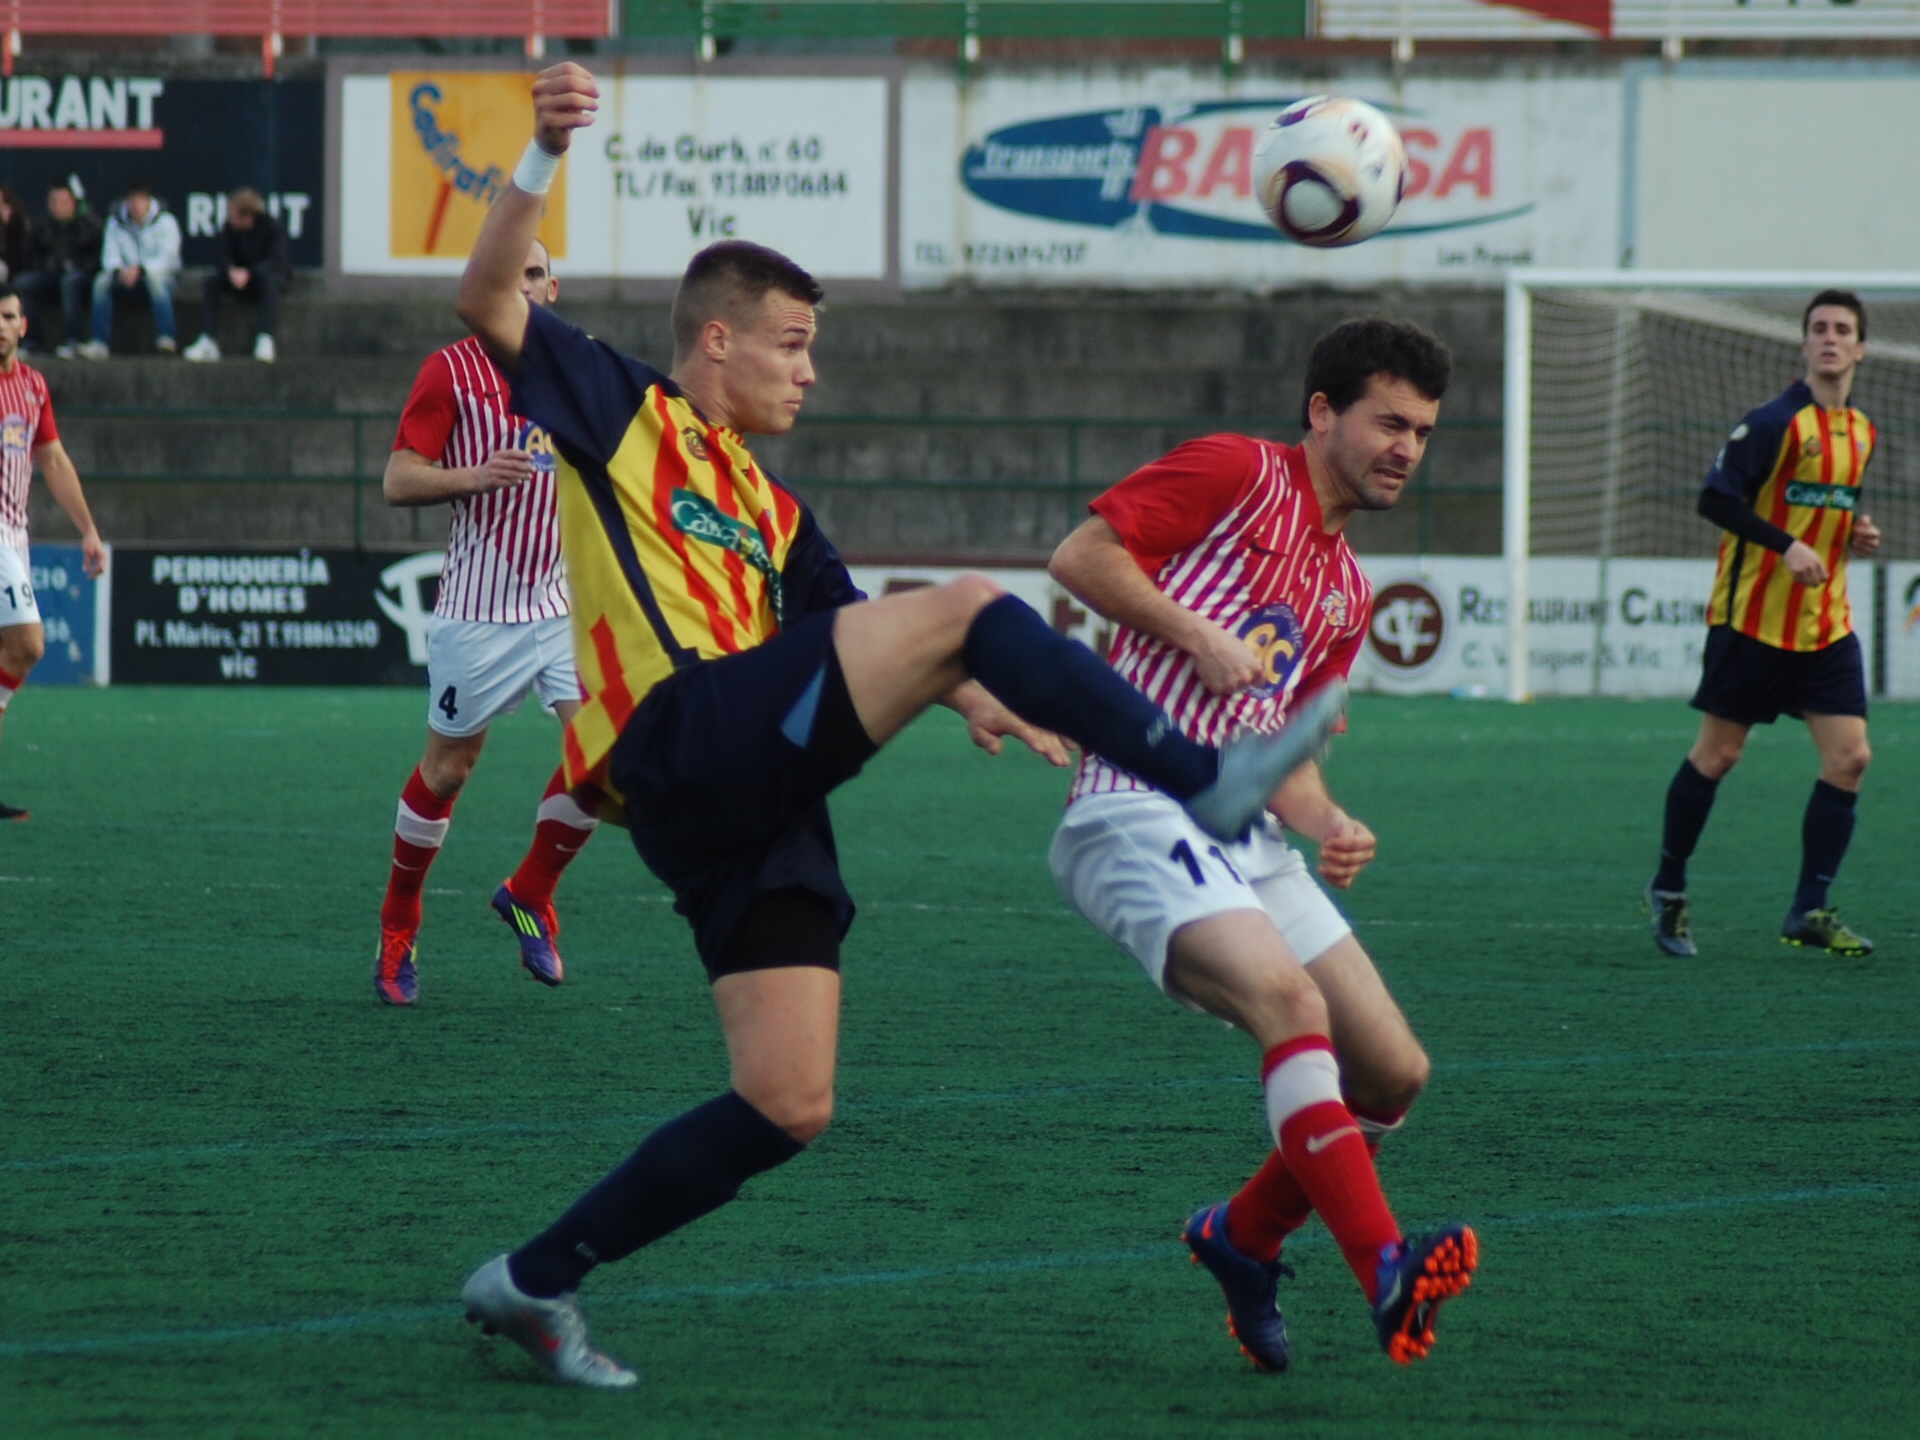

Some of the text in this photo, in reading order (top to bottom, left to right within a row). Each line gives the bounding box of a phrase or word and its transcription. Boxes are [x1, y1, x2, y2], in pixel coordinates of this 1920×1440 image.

[787, 138, 821, 162] 60
[1129, 126, 1494, 200] BASA
[687, 204, 737, 238] Vic
[4, 584, 33, 610] 19
[178, 586, 308, 614] D'HOMES
[438, 684, 458, 721] 4
